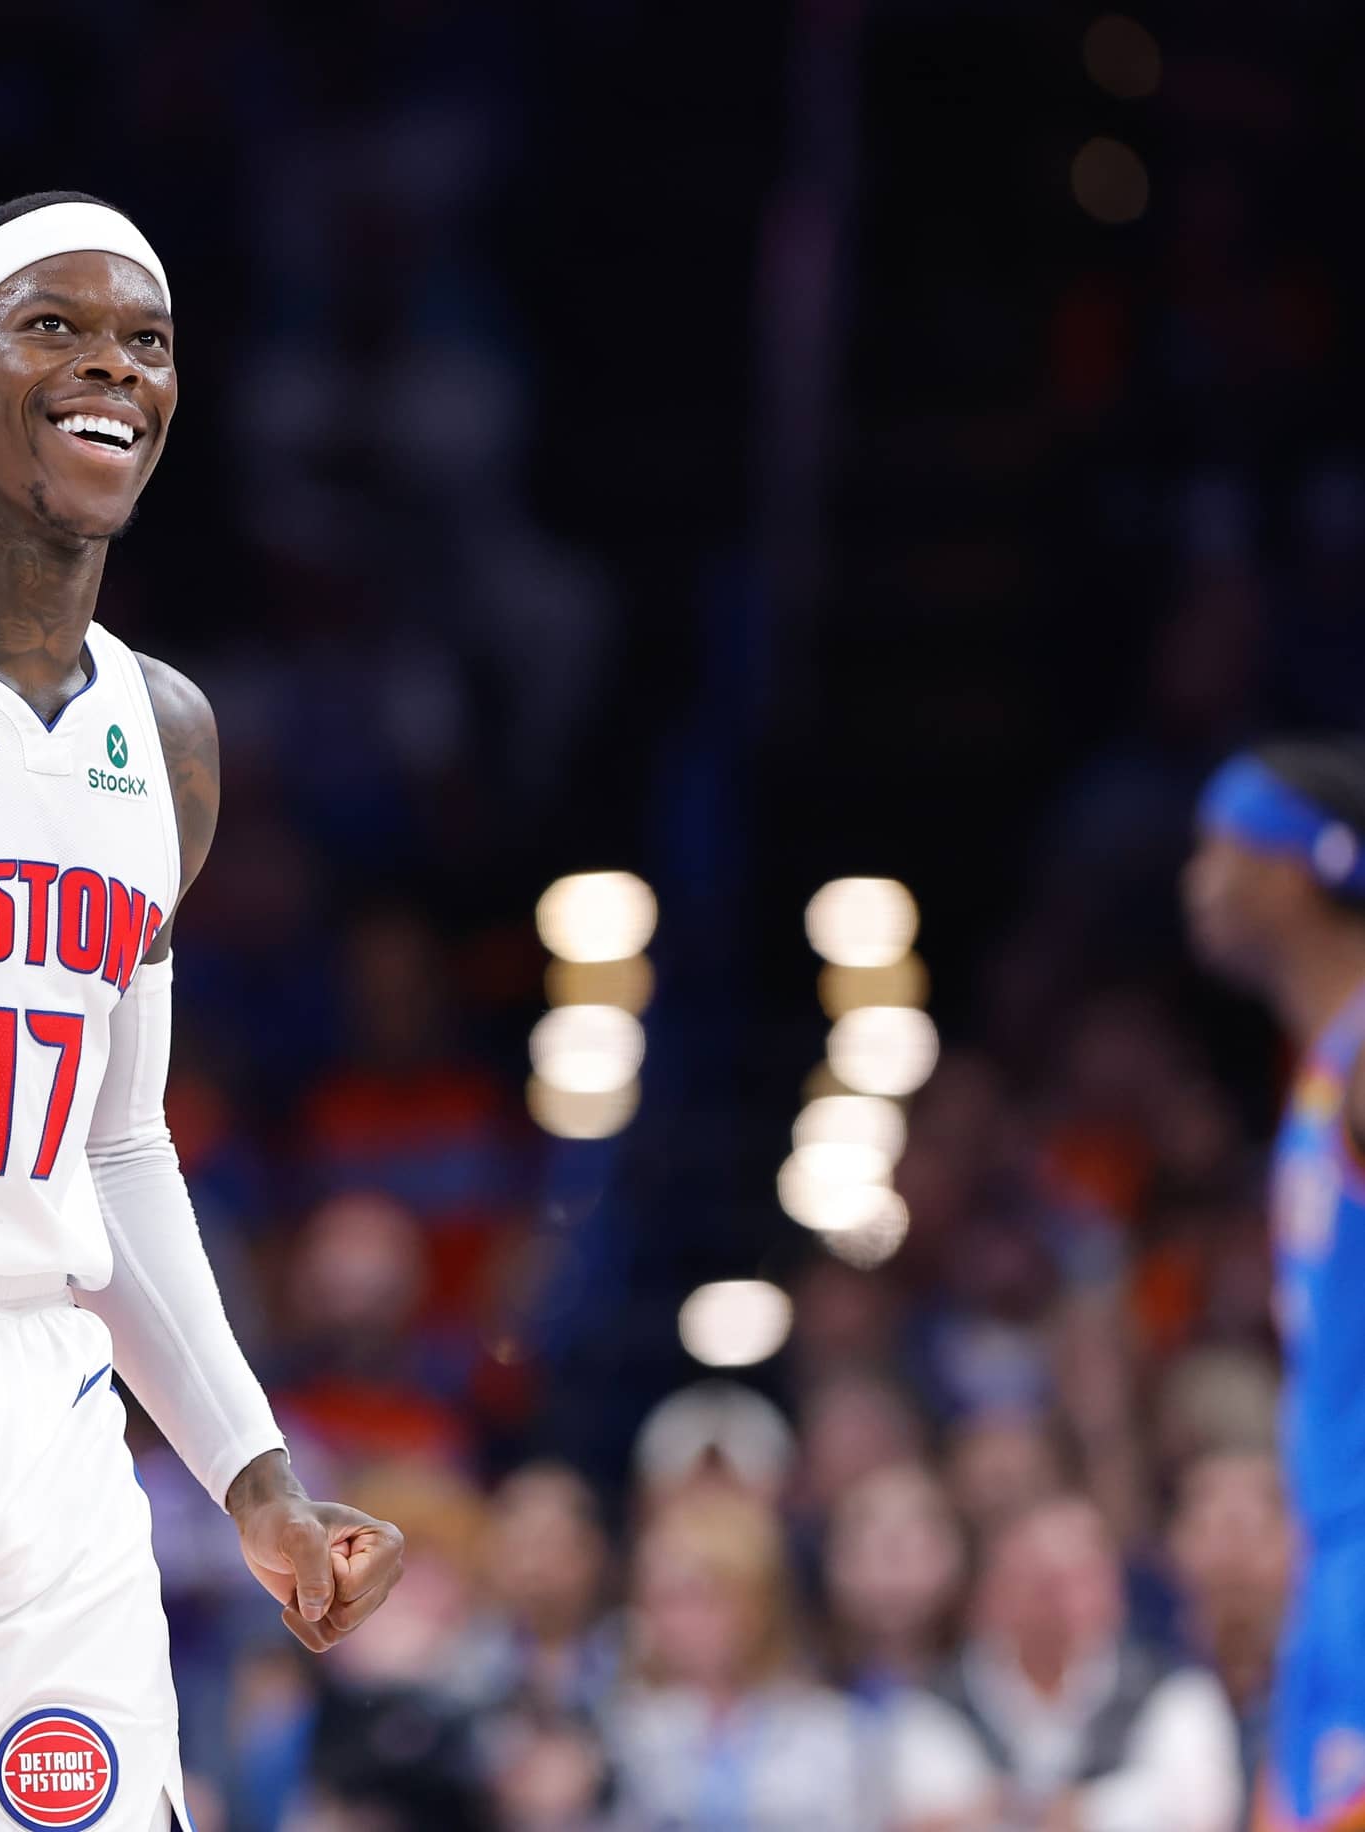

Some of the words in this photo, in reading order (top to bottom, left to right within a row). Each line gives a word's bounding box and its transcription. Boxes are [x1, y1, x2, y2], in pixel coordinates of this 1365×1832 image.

[87, 767, 148, 797] StockX
[18, 1751, 94, 1772] DETROIT
[18, 1771, 95, 1793] PISTONS
